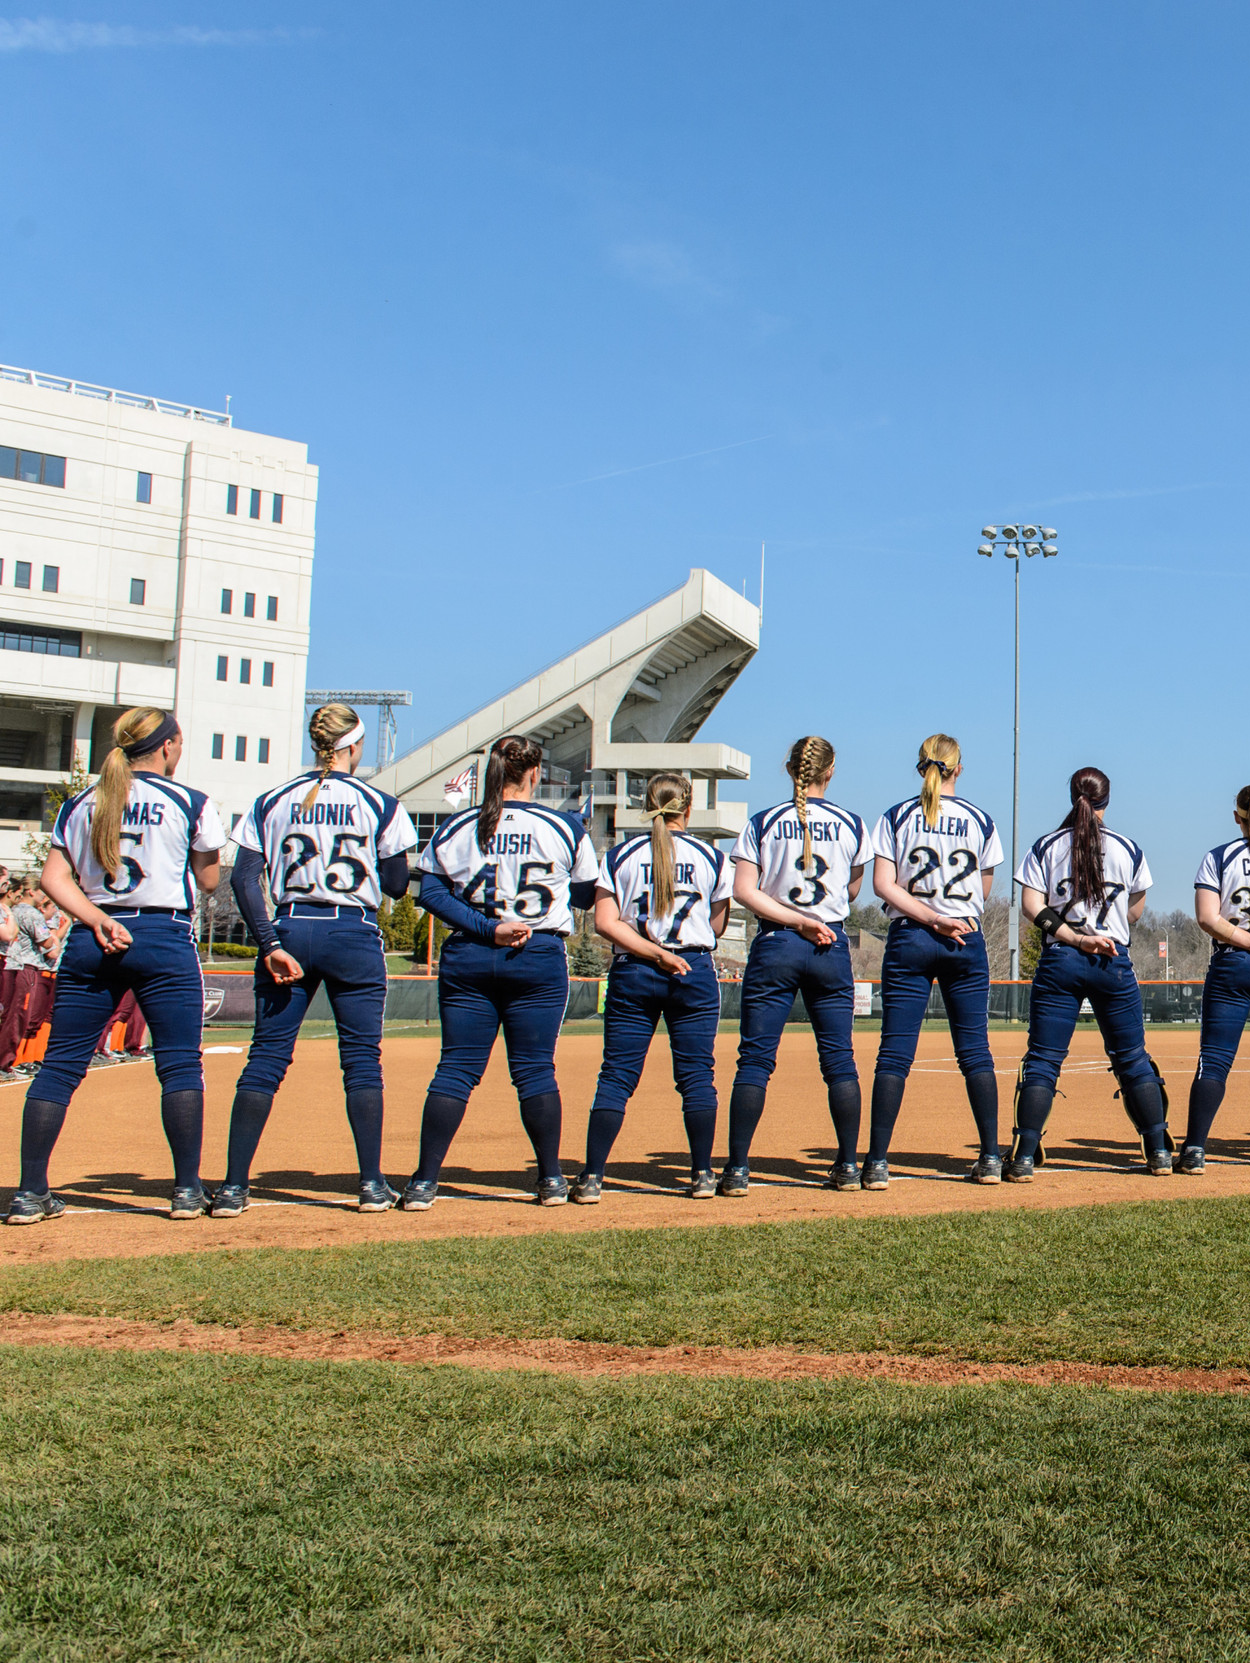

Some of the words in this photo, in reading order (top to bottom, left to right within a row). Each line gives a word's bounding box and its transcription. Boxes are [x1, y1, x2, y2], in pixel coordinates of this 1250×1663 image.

[84, 802, 165, 826] TMAS
[103, 831, 146, 895] 5
[281, 832, 370, 895] 25
[486, 833, 532, 855] RUSH
[462, 861, 556, 920] 45
[640, 863, 695, 885] TOR
[788, 853, 830, 907] 3
[908, 846, 978, 902] 22
[632, 889, 702, 945] 17
[1056, 877, 1126, 931] 27
